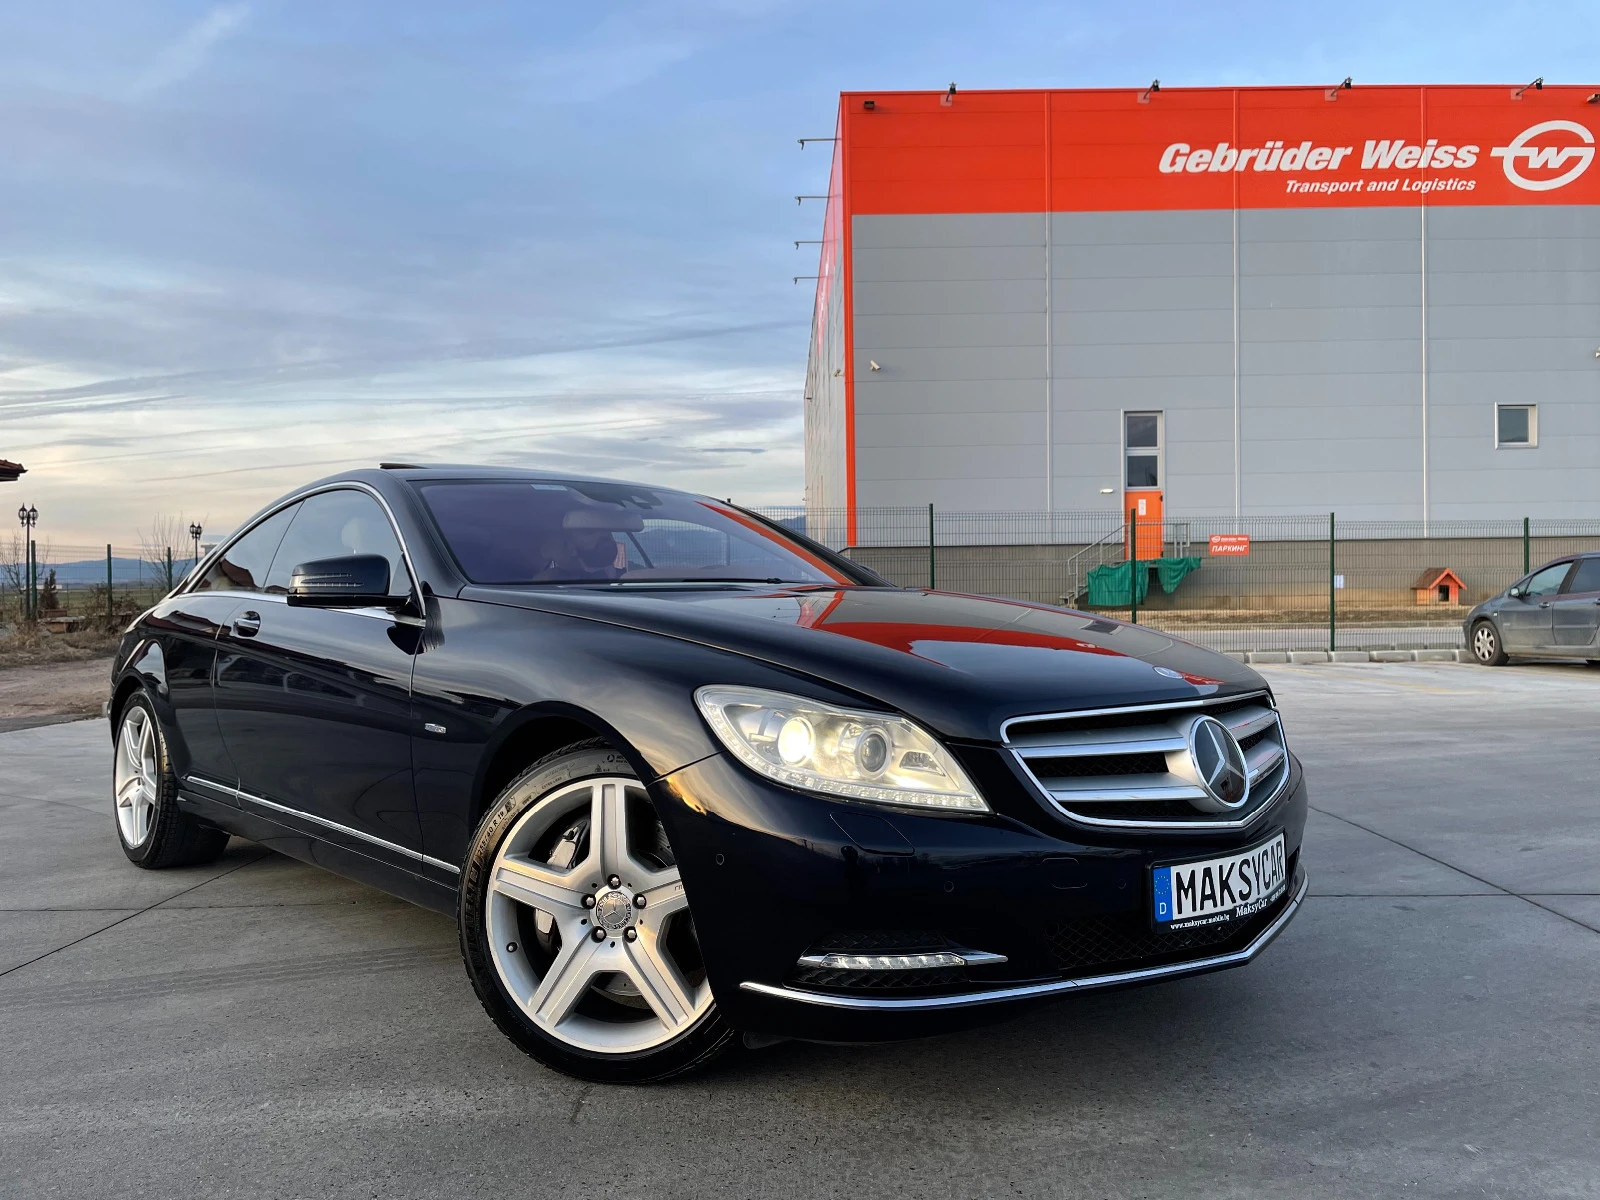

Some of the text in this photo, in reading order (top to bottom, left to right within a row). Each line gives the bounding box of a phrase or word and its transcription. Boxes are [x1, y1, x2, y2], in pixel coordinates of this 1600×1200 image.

[1158, 139, 1481, 174] Gebrüder Weiss
[1286, 177, 1477, 195] Transport and Logistics
[1211, 544, 1248, 553] ПАРКИНГ
[1175, 840, 1285, 915] MAKSYCAR
[1159, 902, 1167, 915] D
[1235, 897, 1268, 918] MaksyCar
